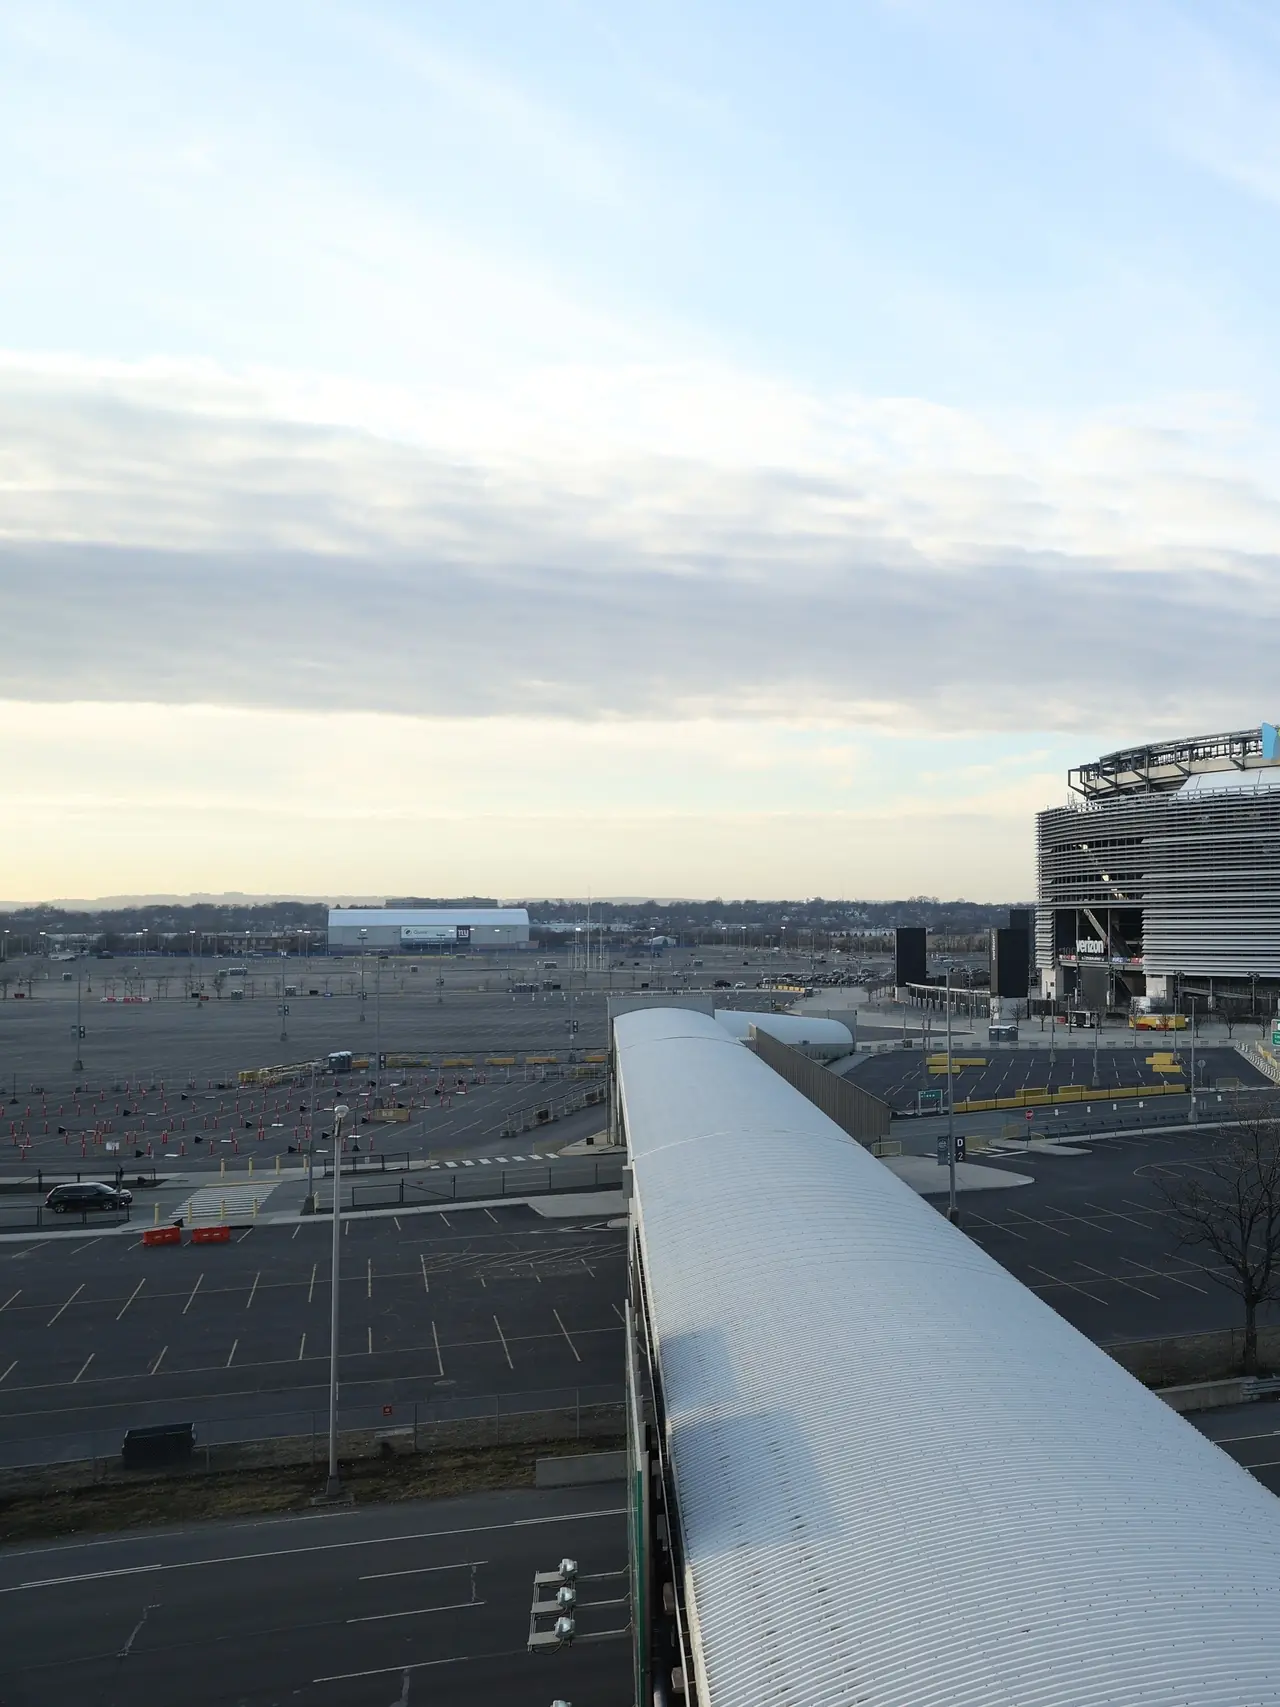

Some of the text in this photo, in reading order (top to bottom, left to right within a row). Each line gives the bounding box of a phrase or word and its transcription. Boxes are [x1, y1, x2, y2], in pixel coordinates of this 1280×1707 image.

[1076, 936, 1104, 954] verizon
[957, 1138, 964, 1147] D
[957, 1151, 964, 1161] 2
